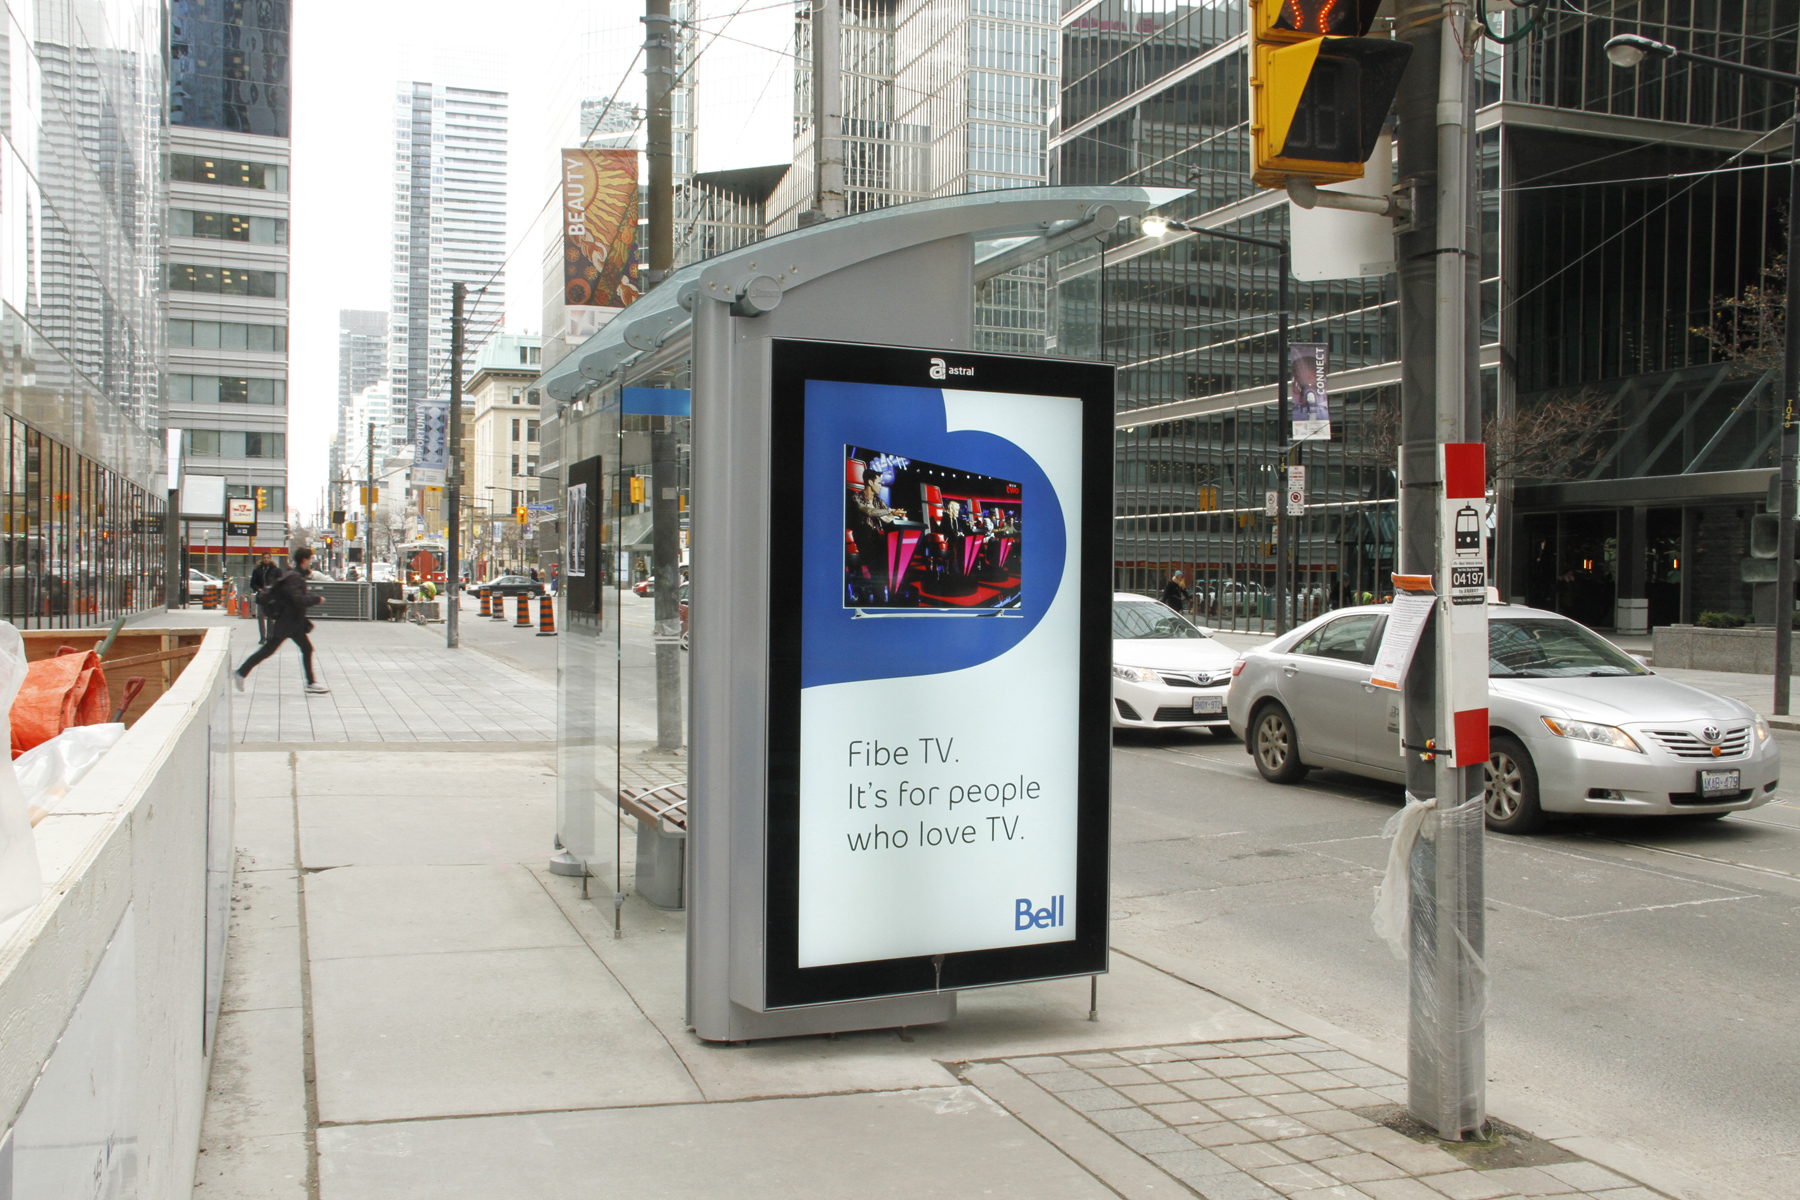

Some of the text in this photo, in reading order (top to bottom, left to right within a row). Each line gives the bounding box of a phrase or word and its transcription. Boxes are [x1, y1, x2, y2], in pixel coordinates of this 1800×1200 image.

[564, 157, 586, 236] BEAUTY
[948, 367, 975, 376] astral
[1315, 347, 1325, 395] CONNECT
[415, 402, 425, 464] OPPORTUNITY
[1006, 485, 1020, 494] two
[1453, 572, 1483, 585] 04197
[848, 737, 959, 768] Fibe TV.
[848, 774, 1041, 811] It's for people
[847, 815, 1025, 852] who love TV.
[1015, 894, 1064, 931] Bell
